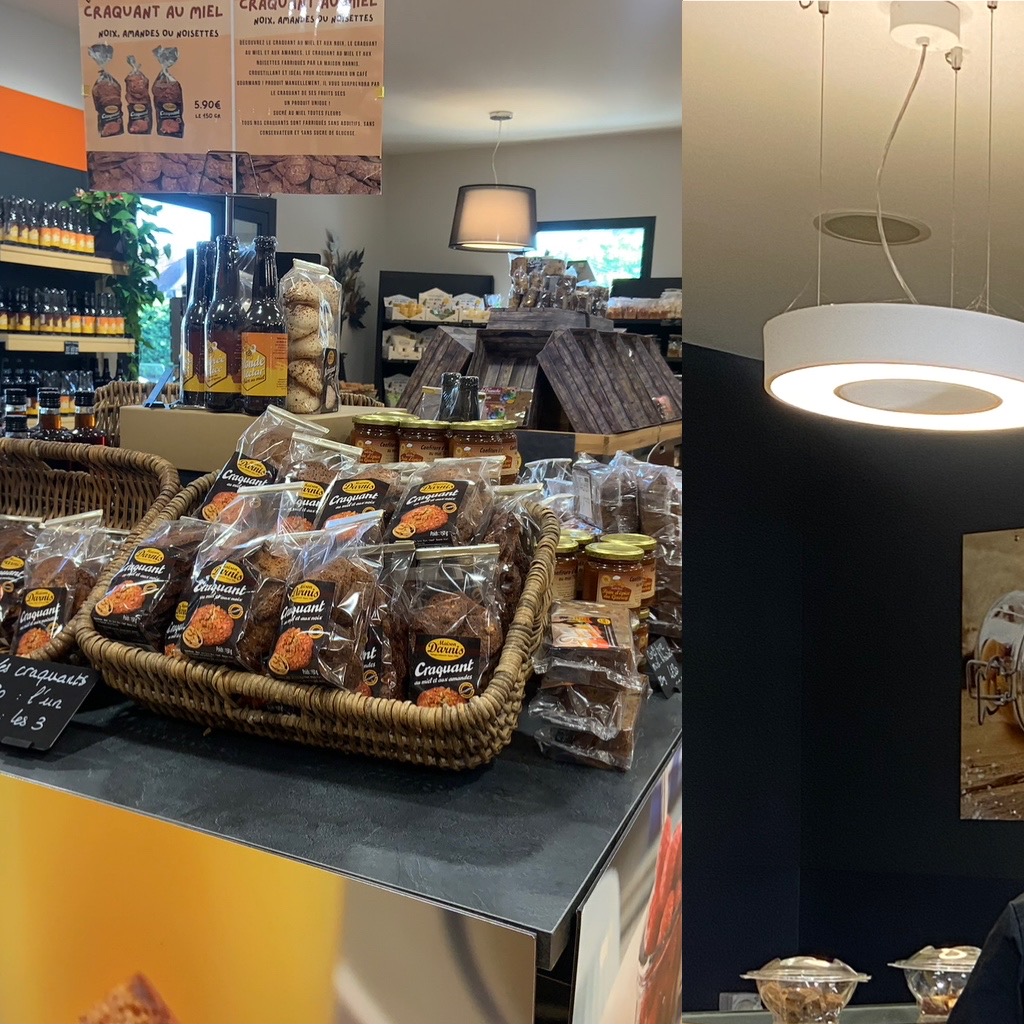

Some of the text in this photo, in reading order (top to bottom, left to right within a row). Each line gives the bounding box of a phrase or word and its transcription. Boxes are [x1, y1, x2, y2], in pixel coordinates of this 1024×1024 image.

[84, 5, 223, 19] CRAQUANT AU MIEL
[278, 16, 314, 24] AMANDES
[318, 15, 329, 23] OU
[331, 14, 373, 24] NOISETTES
[122, 30, 160, 38] AMANDES
[177, 29, 219, 38] NOISETTES
[194, 100, 221, 110] 5.90€
[222, 469, 271, 488] Craquant
[329, 492, 379, 506] Craquant
[405, 489, 460, 505] Craquant
[20, 603, 61, 623] Craquant
[427, 642, 465, 656] Darnis
[14, 665, 89, 687] craquants
[414, 658, 475, 679] Craquant
[422, 677, 432, 685] miel
[449, 674, 473, 682] amandes
[27, 685, 63, 709] l'un
[10, 708, 47, 731] les 3
